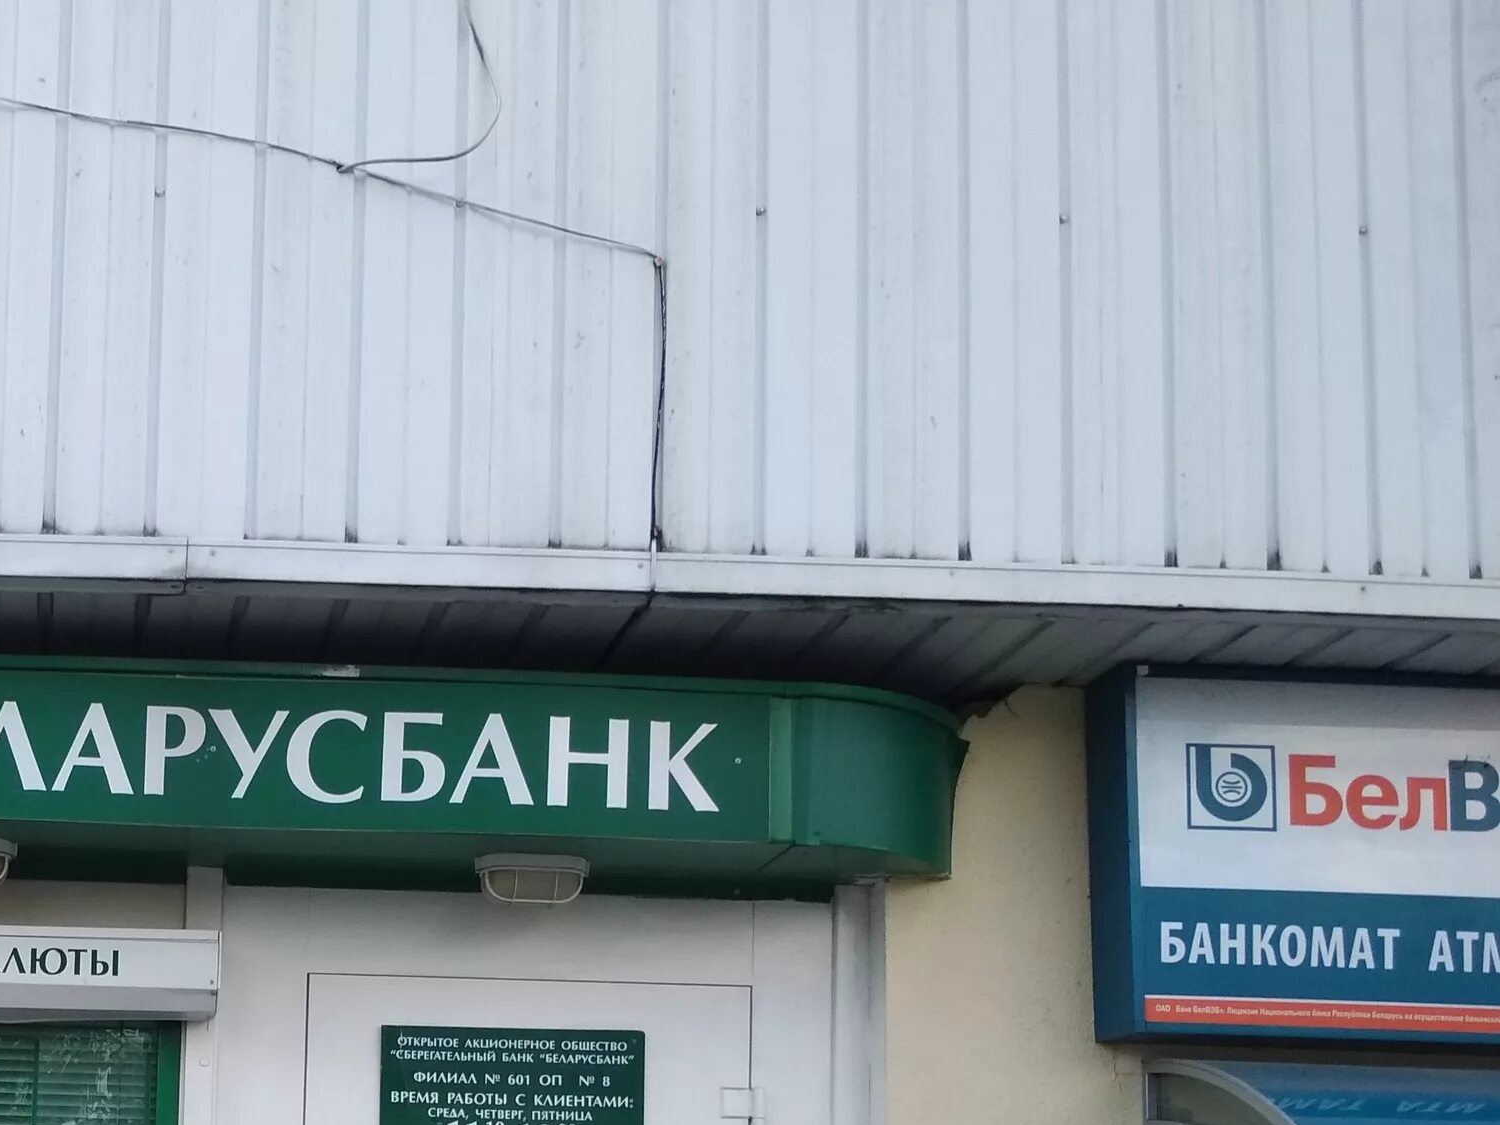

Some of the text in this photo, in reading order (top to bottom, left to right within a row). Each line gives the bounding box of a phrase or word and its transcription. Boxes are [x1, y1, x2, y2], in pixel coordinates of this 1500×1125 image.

[1160, 921, 1400, 970] БАНКОМАТ
[397, 1037, 628, 1051] ОТКРЫТОЕ АКЦИОНЕРНОЕ ОБЩЕСТВО
[502, 1052, 534, 1063] БАНК
[413, 1071, 478, 1084] ФИЛИАЛ
[508, 1074, 530, 1086] 601
[539, 1074, 562, 1086] ОП
[602, 1076, 611, 1087] 8
[390, 1091, 634, 1108] ВРЕМЯ РАБОТЫ С КЛИЕНТАМИ:
[427, 1107, 593, 1122] СРЕДА, ЧЕТВЕРГ, ПЯТНИЦА
